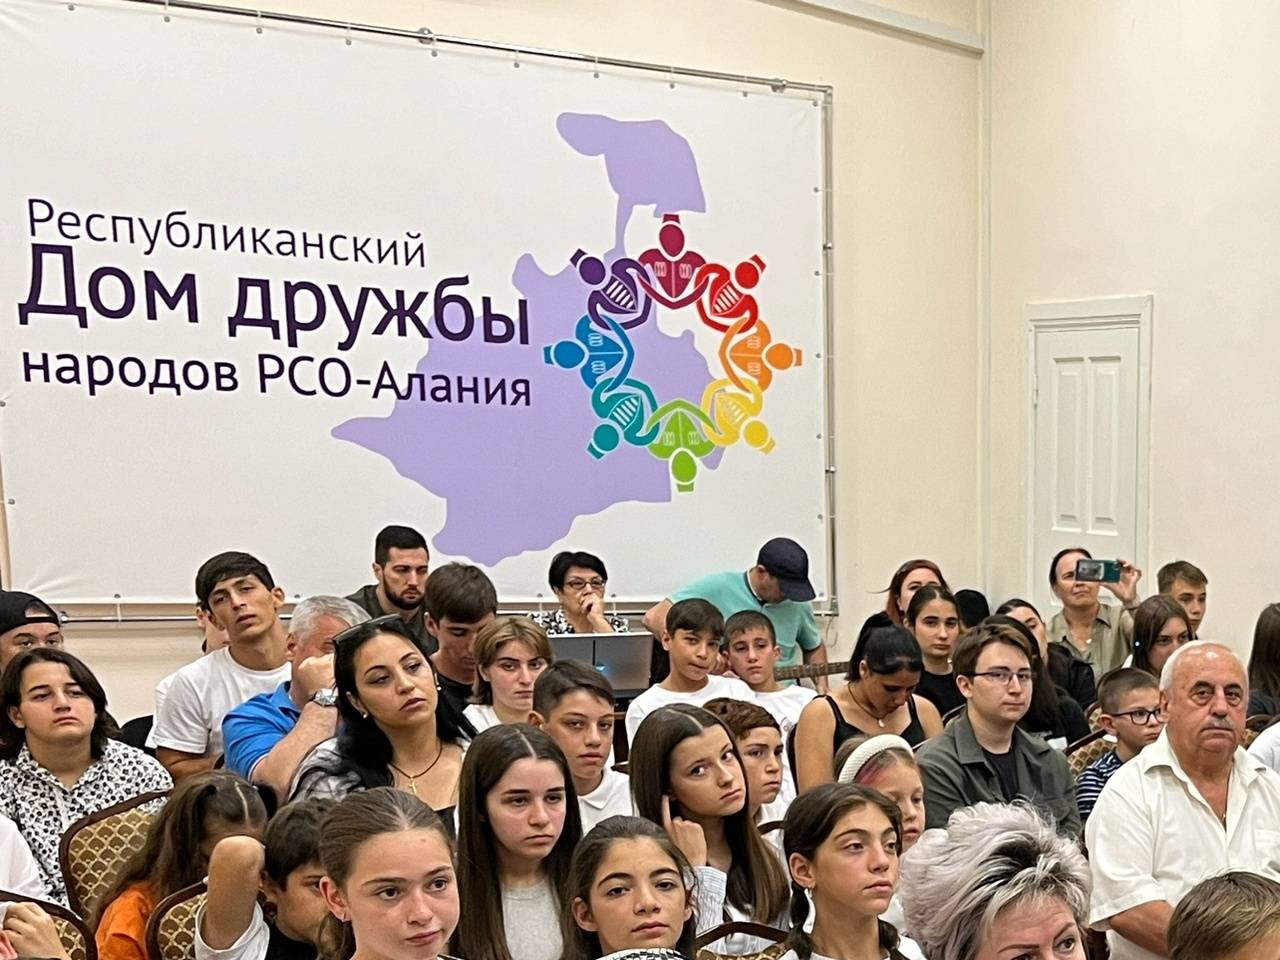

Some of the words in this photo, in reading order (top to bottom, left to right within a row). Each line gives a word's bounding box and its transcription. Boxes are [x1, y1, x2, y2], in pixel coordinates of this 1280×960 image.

[28, 198, 426, 268] Республиканский
[18, 243, 199, 329] Дом
[227, 274, 530, 351] дружбы
[22, 351, 239, 397] народов
[258, 353, 531, 406] РСО-Алания
